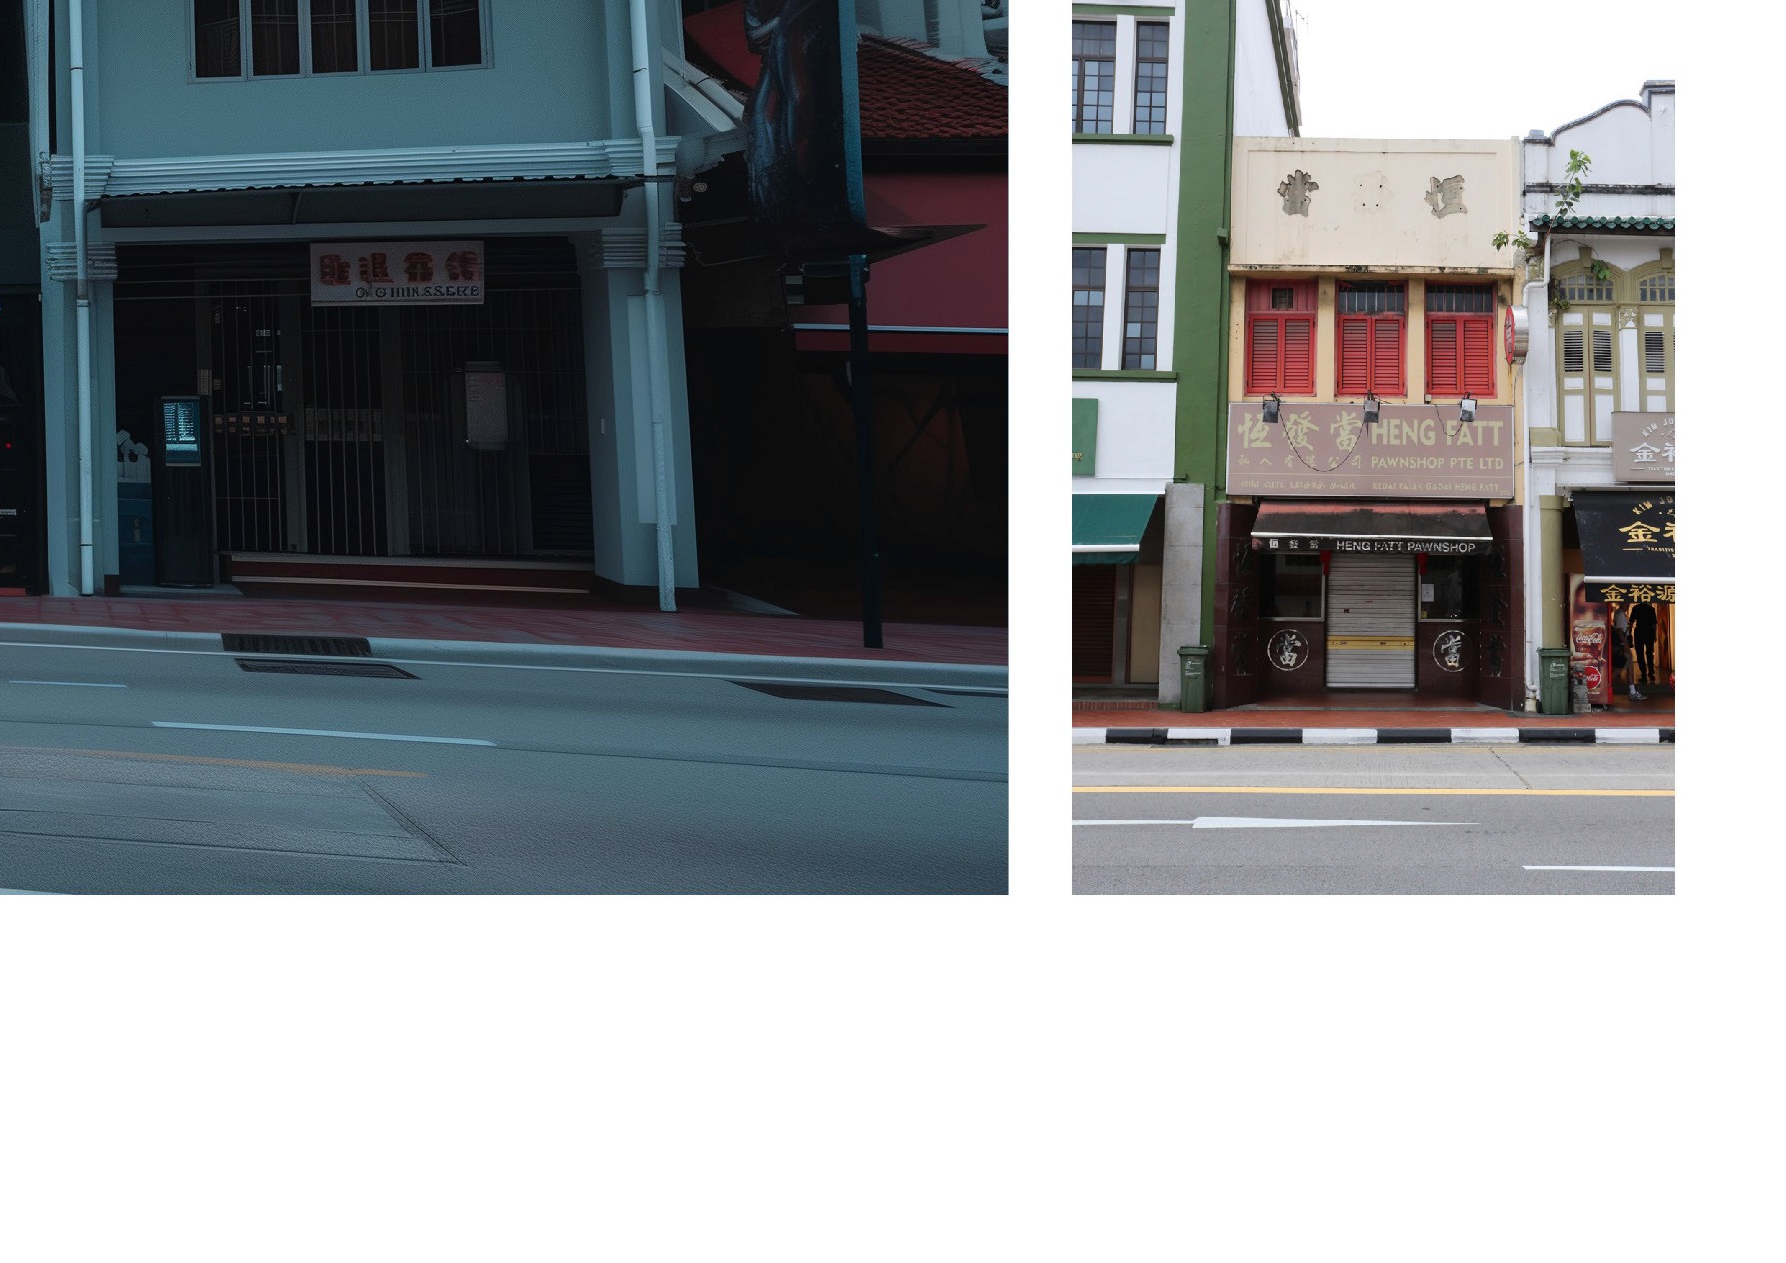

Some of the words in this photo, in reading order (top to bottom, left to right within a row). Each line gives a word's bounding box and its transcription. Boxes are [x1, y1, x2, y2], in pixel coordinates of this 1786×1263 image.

[1371, 419, 1436, 446] HENG
[1446, 420, 1504, 446] FATT
[1371, 456, 1445, 469] PAWNSHOP
[1450, 457, 1474, 470] PTE
[1479, 458, 1504, 470] LTD
[1455, 483, 1477, 492] HENG
[1479, 483, 1499, 492] FATT
[1336, 540, 1371, 551] HENG
[1374, 541, 1403, 552] FATT
[1407, 541, 1476, 553] PAWNSHOP
